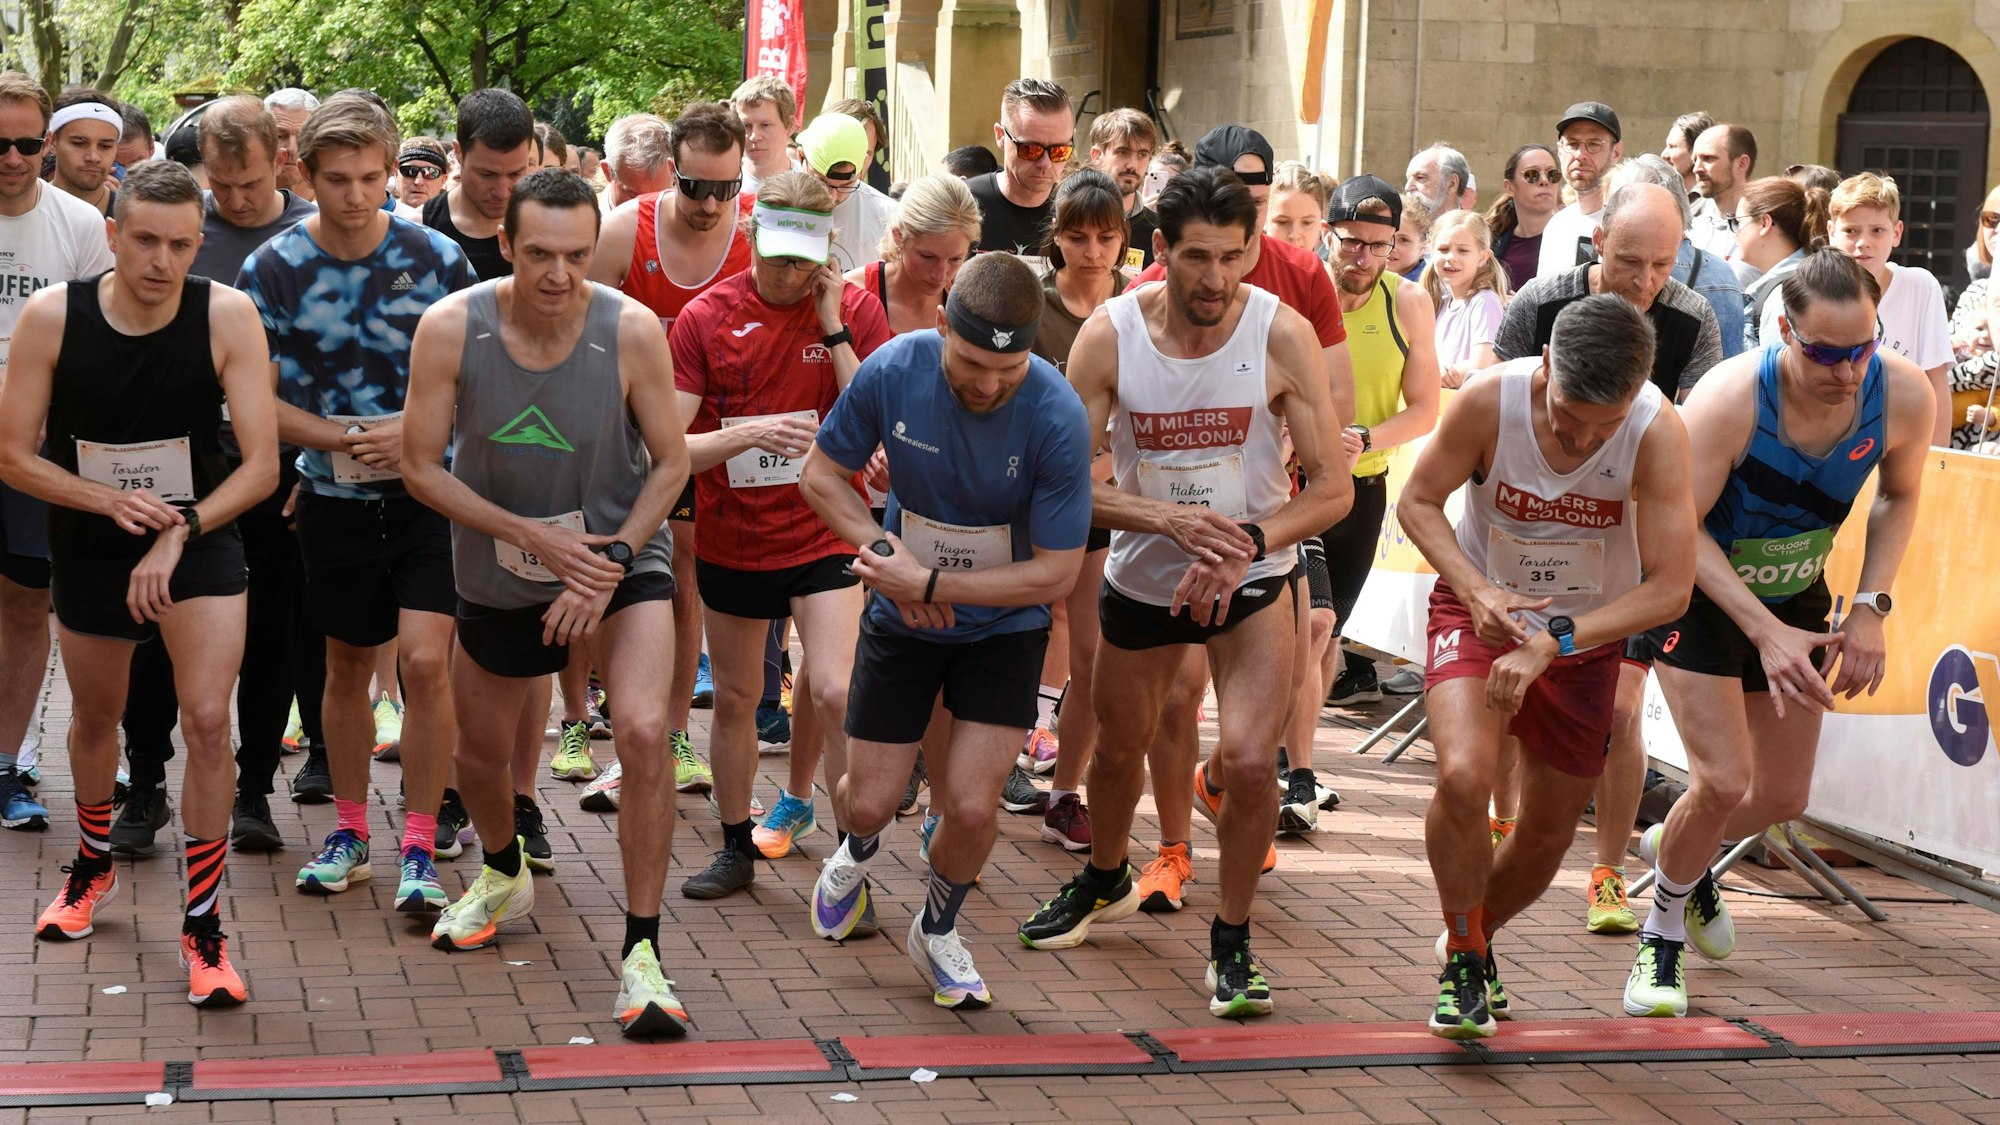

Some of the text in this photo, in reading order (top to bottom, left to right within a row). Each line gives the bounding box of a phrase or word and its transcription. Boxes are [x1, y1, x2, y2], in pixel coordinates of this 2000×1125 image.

[391, 283, 418, 291] adidas
[802, 349, 825, 360] LAZ
[1159, 411, 1229, 431] MILERS
[1160, 428, 1244, 448] COLONIA
[111, 462, 161, 475] Torsten
[759, 455, 789, 469] 872
[118, 477, 154, 491] 753
[1169, 482, 1215, 496] Hakim
[1527, 495, 1597, 512] MILERS
[1525, 508, 1616, 527] COLONIA
[934, 540, 977, 557] Hagen
[1768, 538, 1812, 552] COLOGNE
[1781, 545, 1810, 556] TIMING
[521, 551, 545, 566] 13
[938, 556, 973, 569] 379
[1519, 554, 1571, 568] Torsten
[1736, 553, 1824, 584] 20761
[1530, 570, 1555, 582] 35
